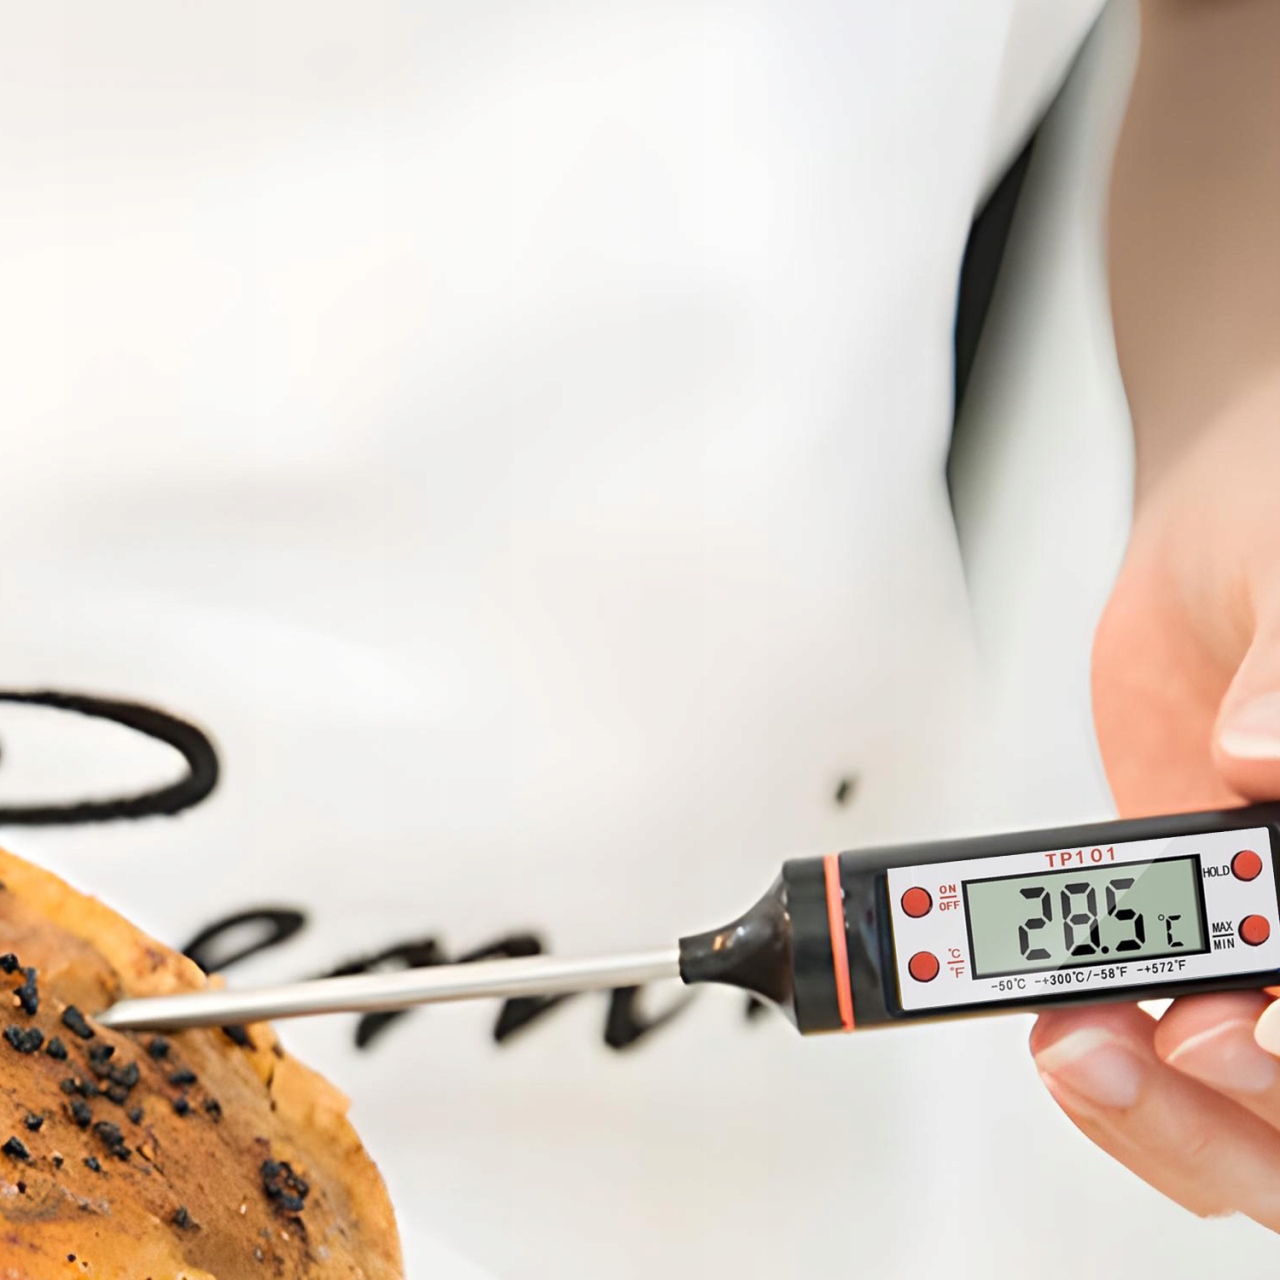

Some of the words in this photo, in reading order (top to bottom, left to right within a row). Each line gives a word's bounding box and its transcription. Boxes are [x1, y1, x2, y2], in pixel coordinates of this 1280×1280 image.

[1044, 846, 1117, 868] TP101
[1202, 863, 1230, 879] HOLD
[939, 884, 957, 895] ON
[939, 899, 961, 911] OFF
[1018, 877, 1146, 961] 28.5
[1212, 920, 1234, 933] MAX
[1214, 937, 1236, 950] MIN
